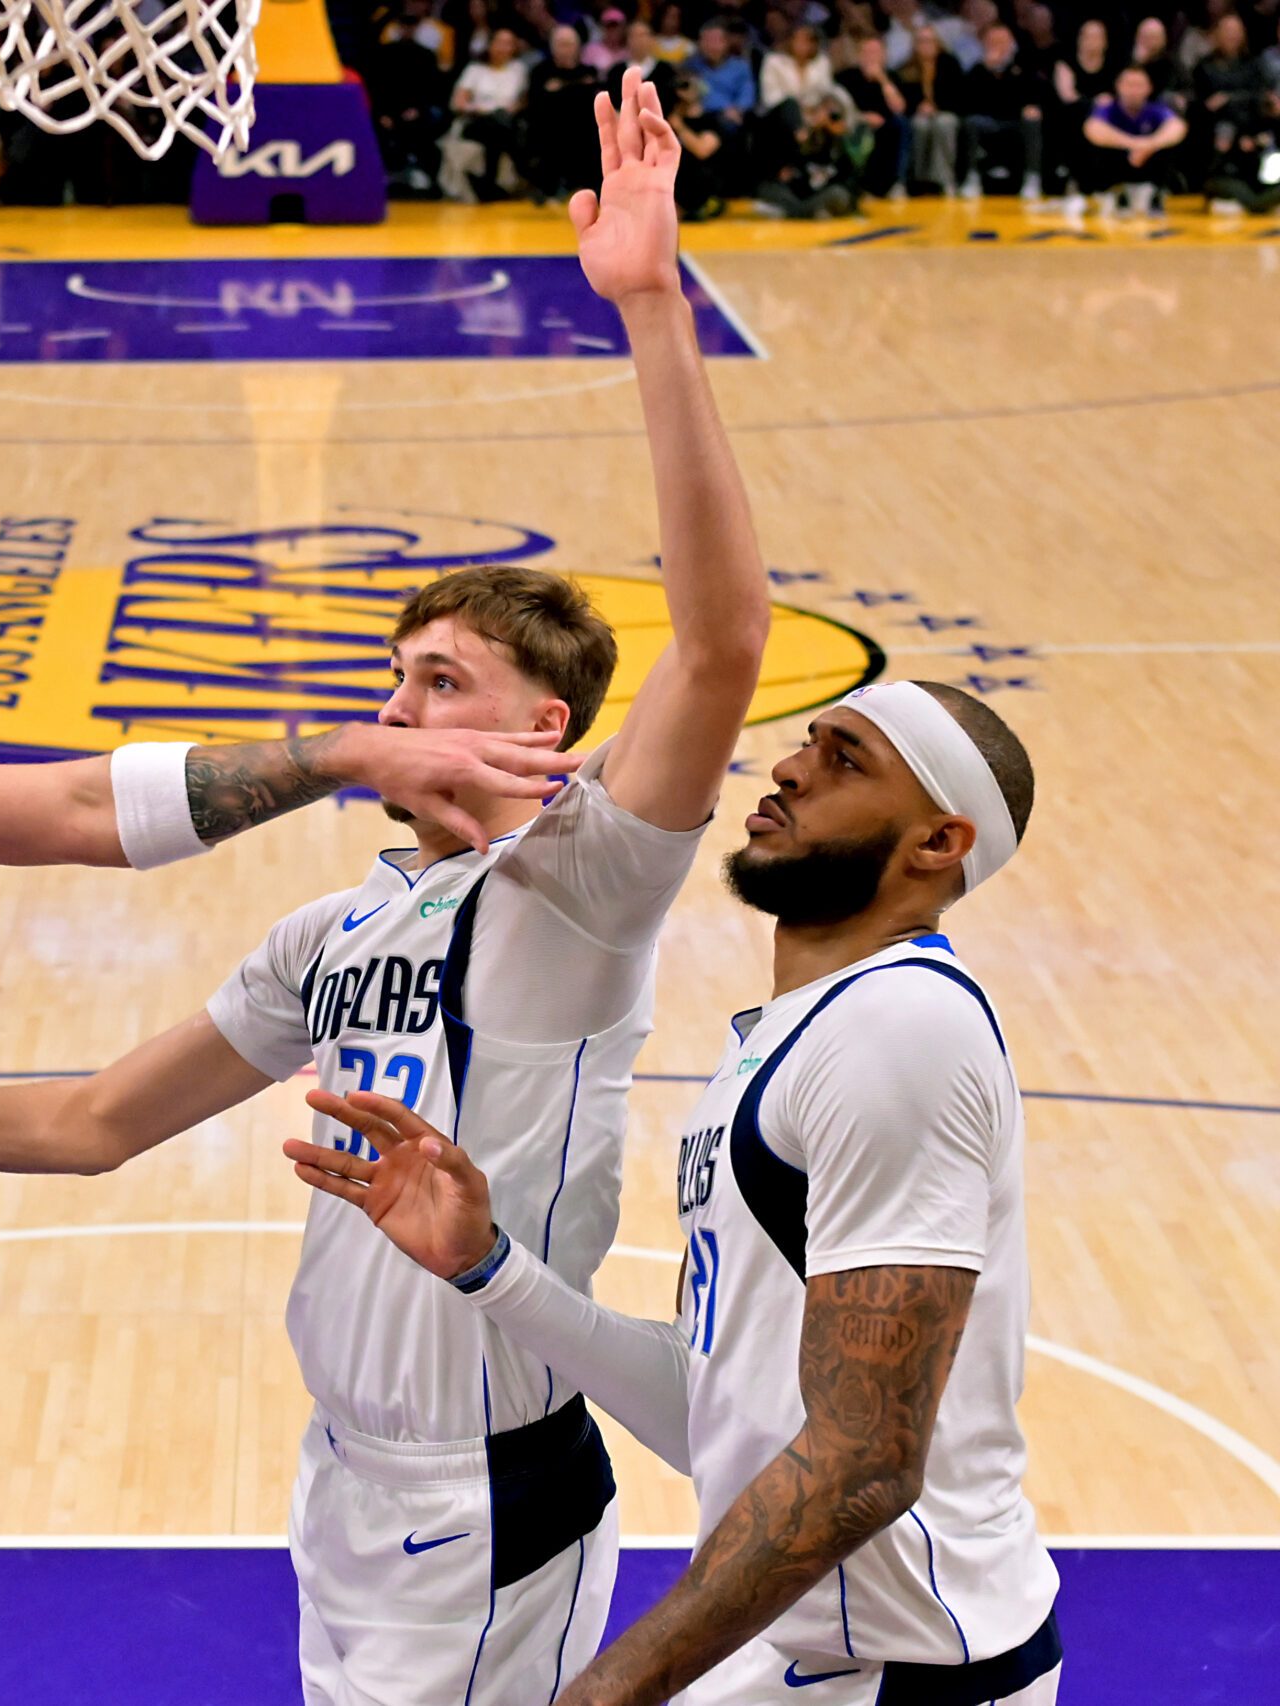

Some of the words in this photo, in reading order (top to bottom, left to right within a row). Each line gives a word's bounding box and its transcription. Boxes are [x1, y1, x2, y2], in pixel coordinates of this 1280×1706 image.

[218, 139, 355, 177] KIA
[311, 954, 446, 1047] DALAS
[677, 1124, 726, 1216] ALLAS
